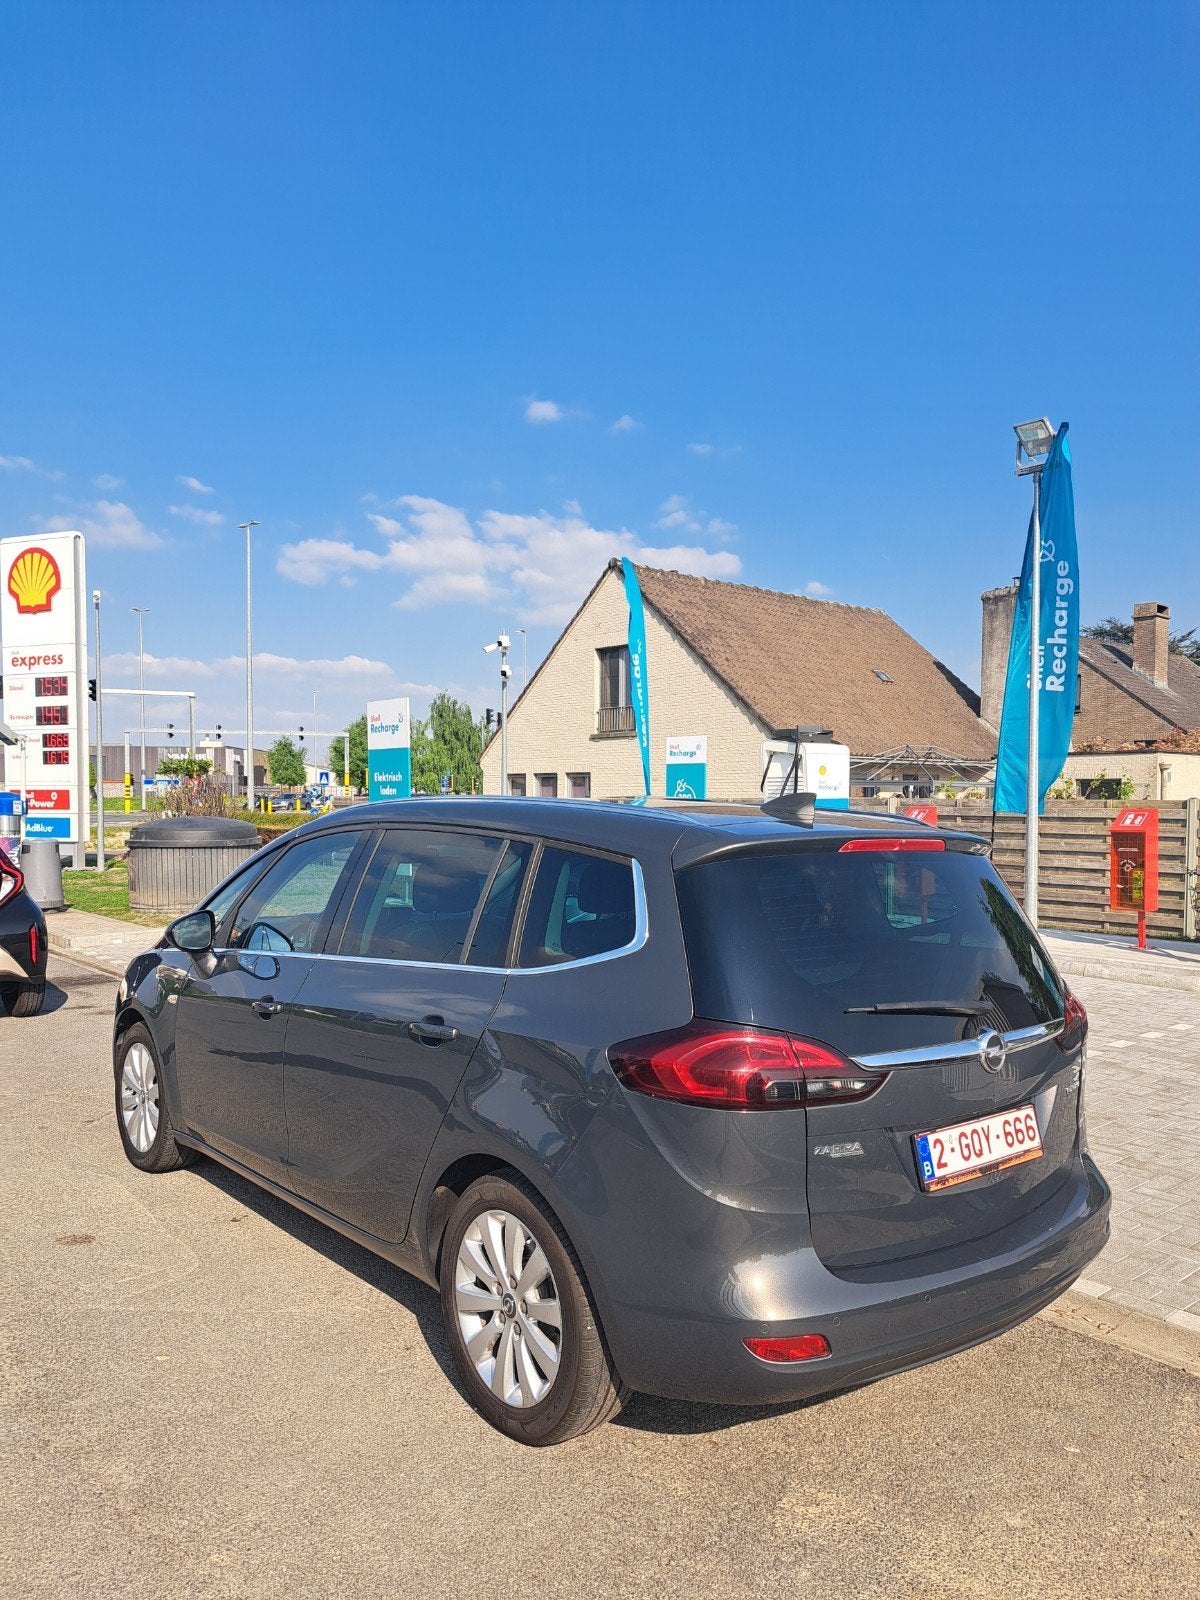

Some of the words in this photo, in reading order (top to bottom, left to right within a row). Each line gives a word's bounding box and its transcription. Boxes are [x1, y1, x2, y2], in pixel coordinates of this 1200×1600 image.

[1045, 560, 1074, 692] Recharge
[11, 654, 64, 670] express
[370, 723, 400, 735] Recharge
[669, 750, 697, 758] Recharge
[374, 772, 403, 782] Elektrisch
[380, 785, 397, 796] laden
[26, 822, 54, 833] AdBlue
[923, 1160, 933, 1177] B
